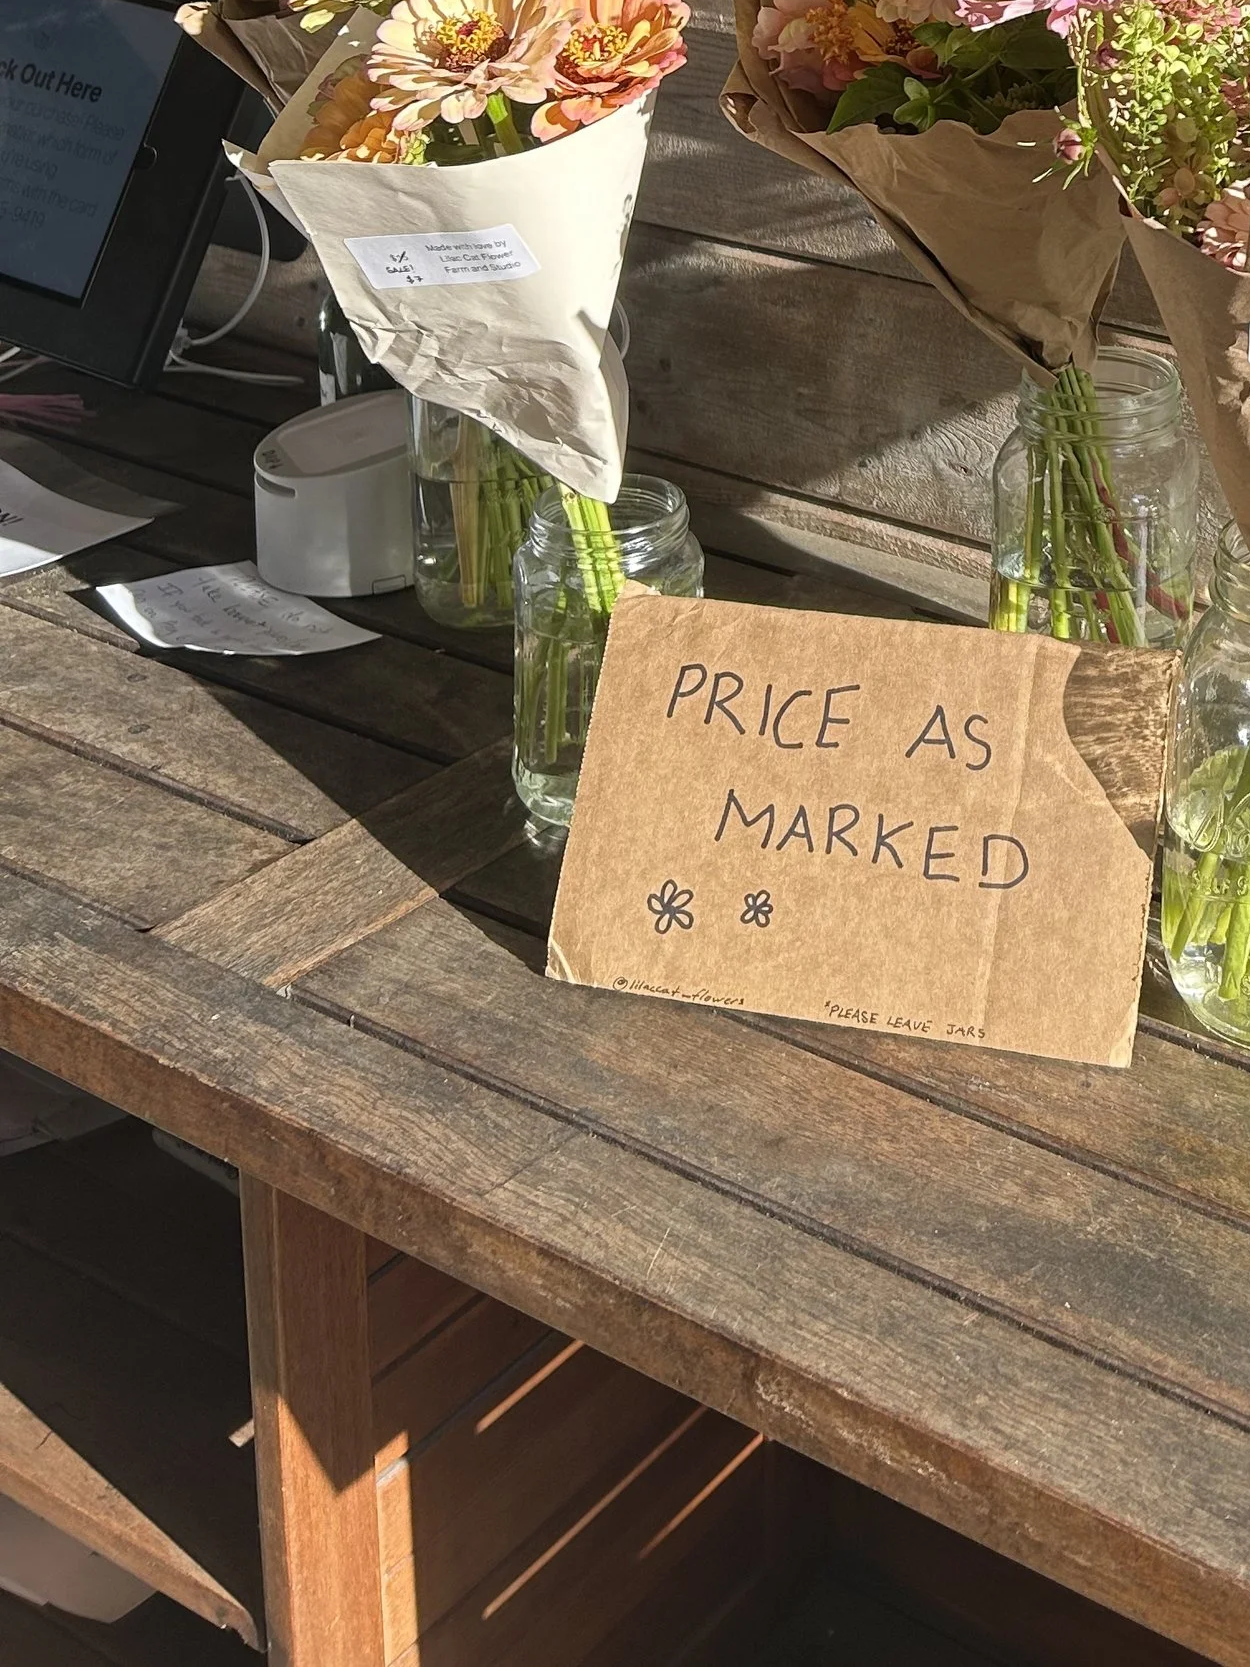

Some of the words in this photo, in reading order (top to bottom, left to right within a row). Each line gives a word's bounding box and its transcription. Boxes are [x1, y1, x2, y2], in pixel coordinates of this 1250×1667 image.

[20, 63, 56, 91] Out
[55, 72, 103, 103] Here
[424, 243, 452, 252] Made
[453, 242, 472, 251] with
[472, 241, 493, 250] love
[493, 239, 507, 248] by
[439, 254, 463, 263] Lilac
[462, 252, 480, 262] Cat
[480, 249, 514, 262] Flower
[385, 264, 416, 275] SALE!
[444, 265, 471, 275] Farm
[471, 263, 488, 273] and
[489, 260, 521, 272] Studio
[665, 662, 861, 751] PRICE
[904, 704, 993, 772] AS
[713, 787, 1031, 890] MARKED
[886, 1015, 933, 1034] LEAVE
[945, 1023, 987, 1040] JARS
